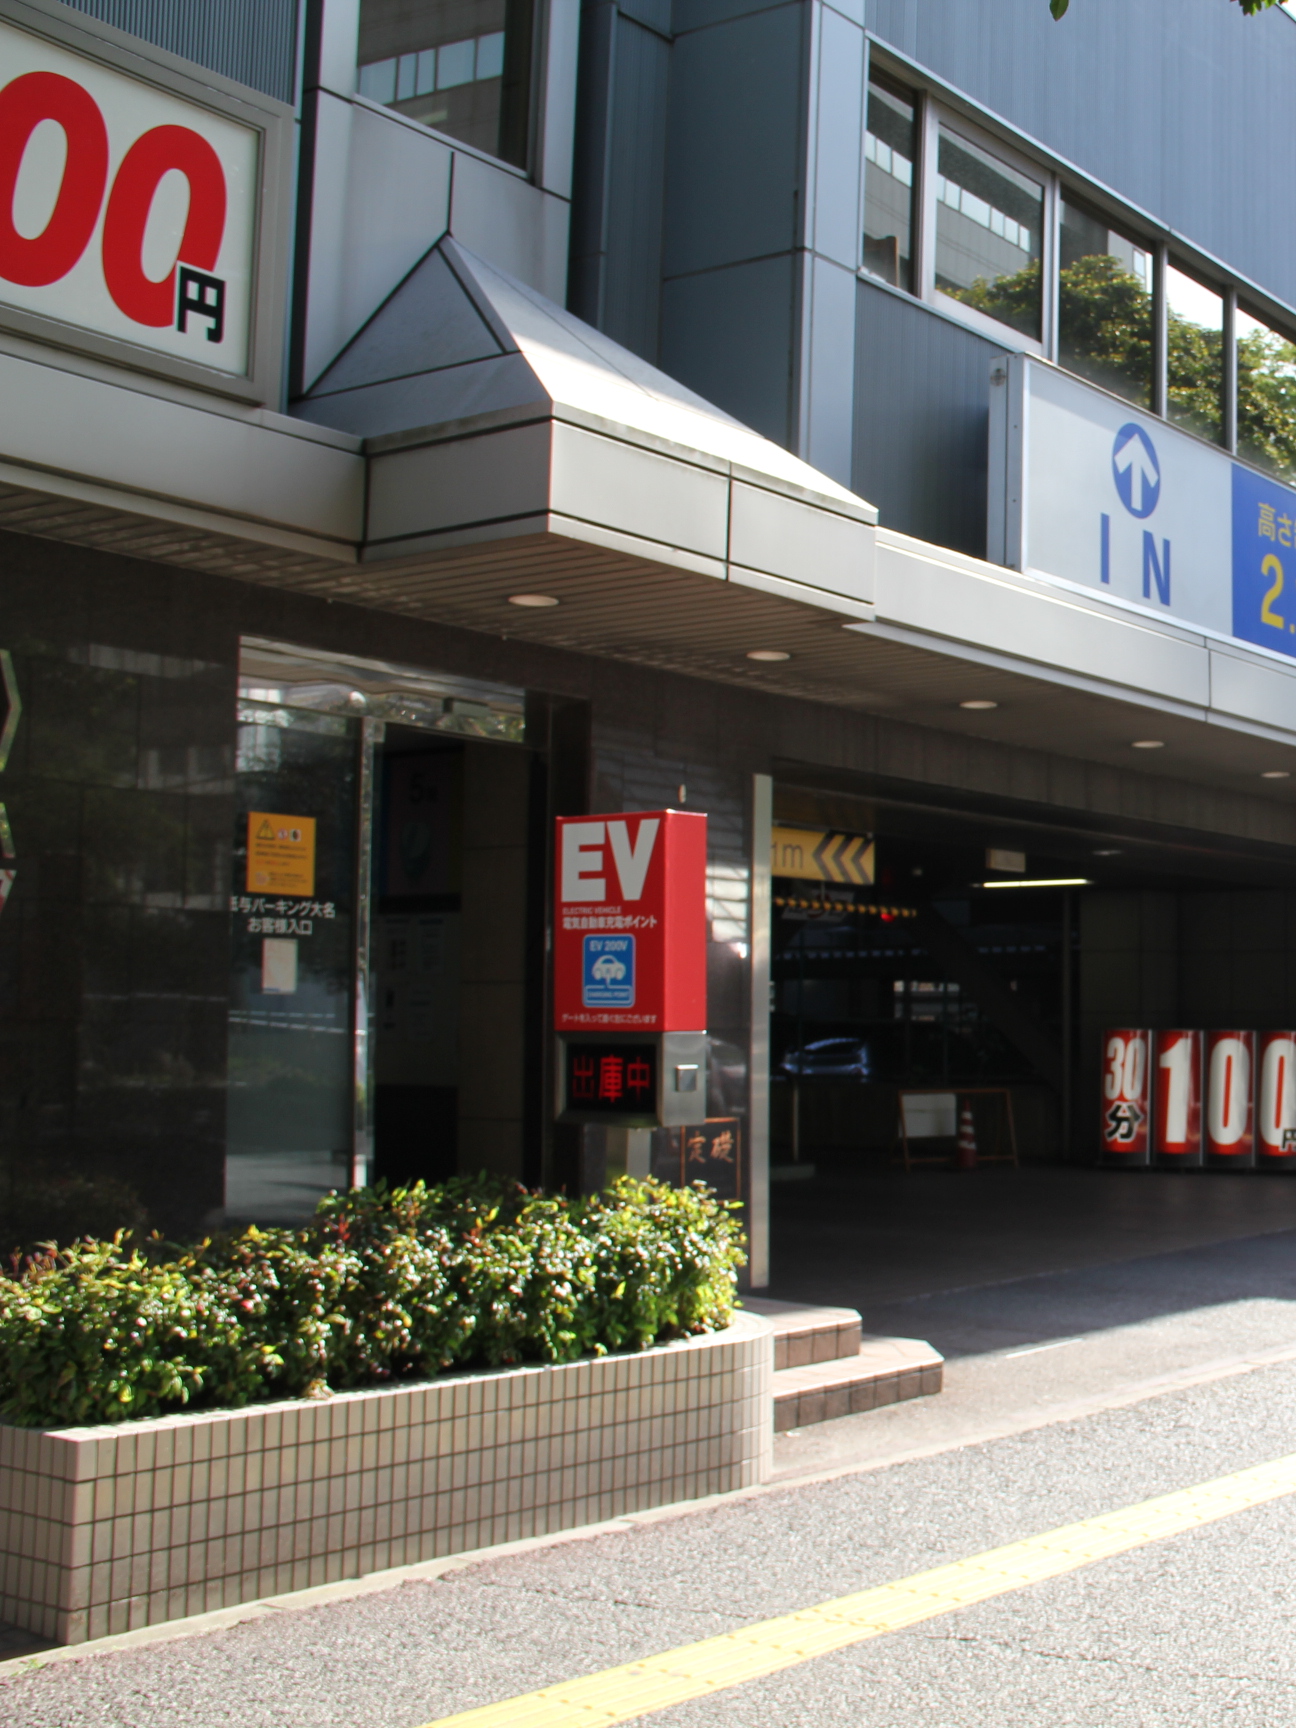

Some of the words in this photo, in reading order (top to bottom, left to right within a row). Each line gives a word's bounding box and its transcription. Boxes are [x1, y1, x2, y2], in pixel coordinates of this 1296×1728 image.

[1100, 512, 1171, 607] IN
[561, 818, 661, 902] EV
[247, 916, 313, 935] お客様入口
[562, 915, 658, 930] 電気自動車充電ポイント
[589, 940, 604, 952] EV
[572, 1054, 650, 1104] 出庫中
